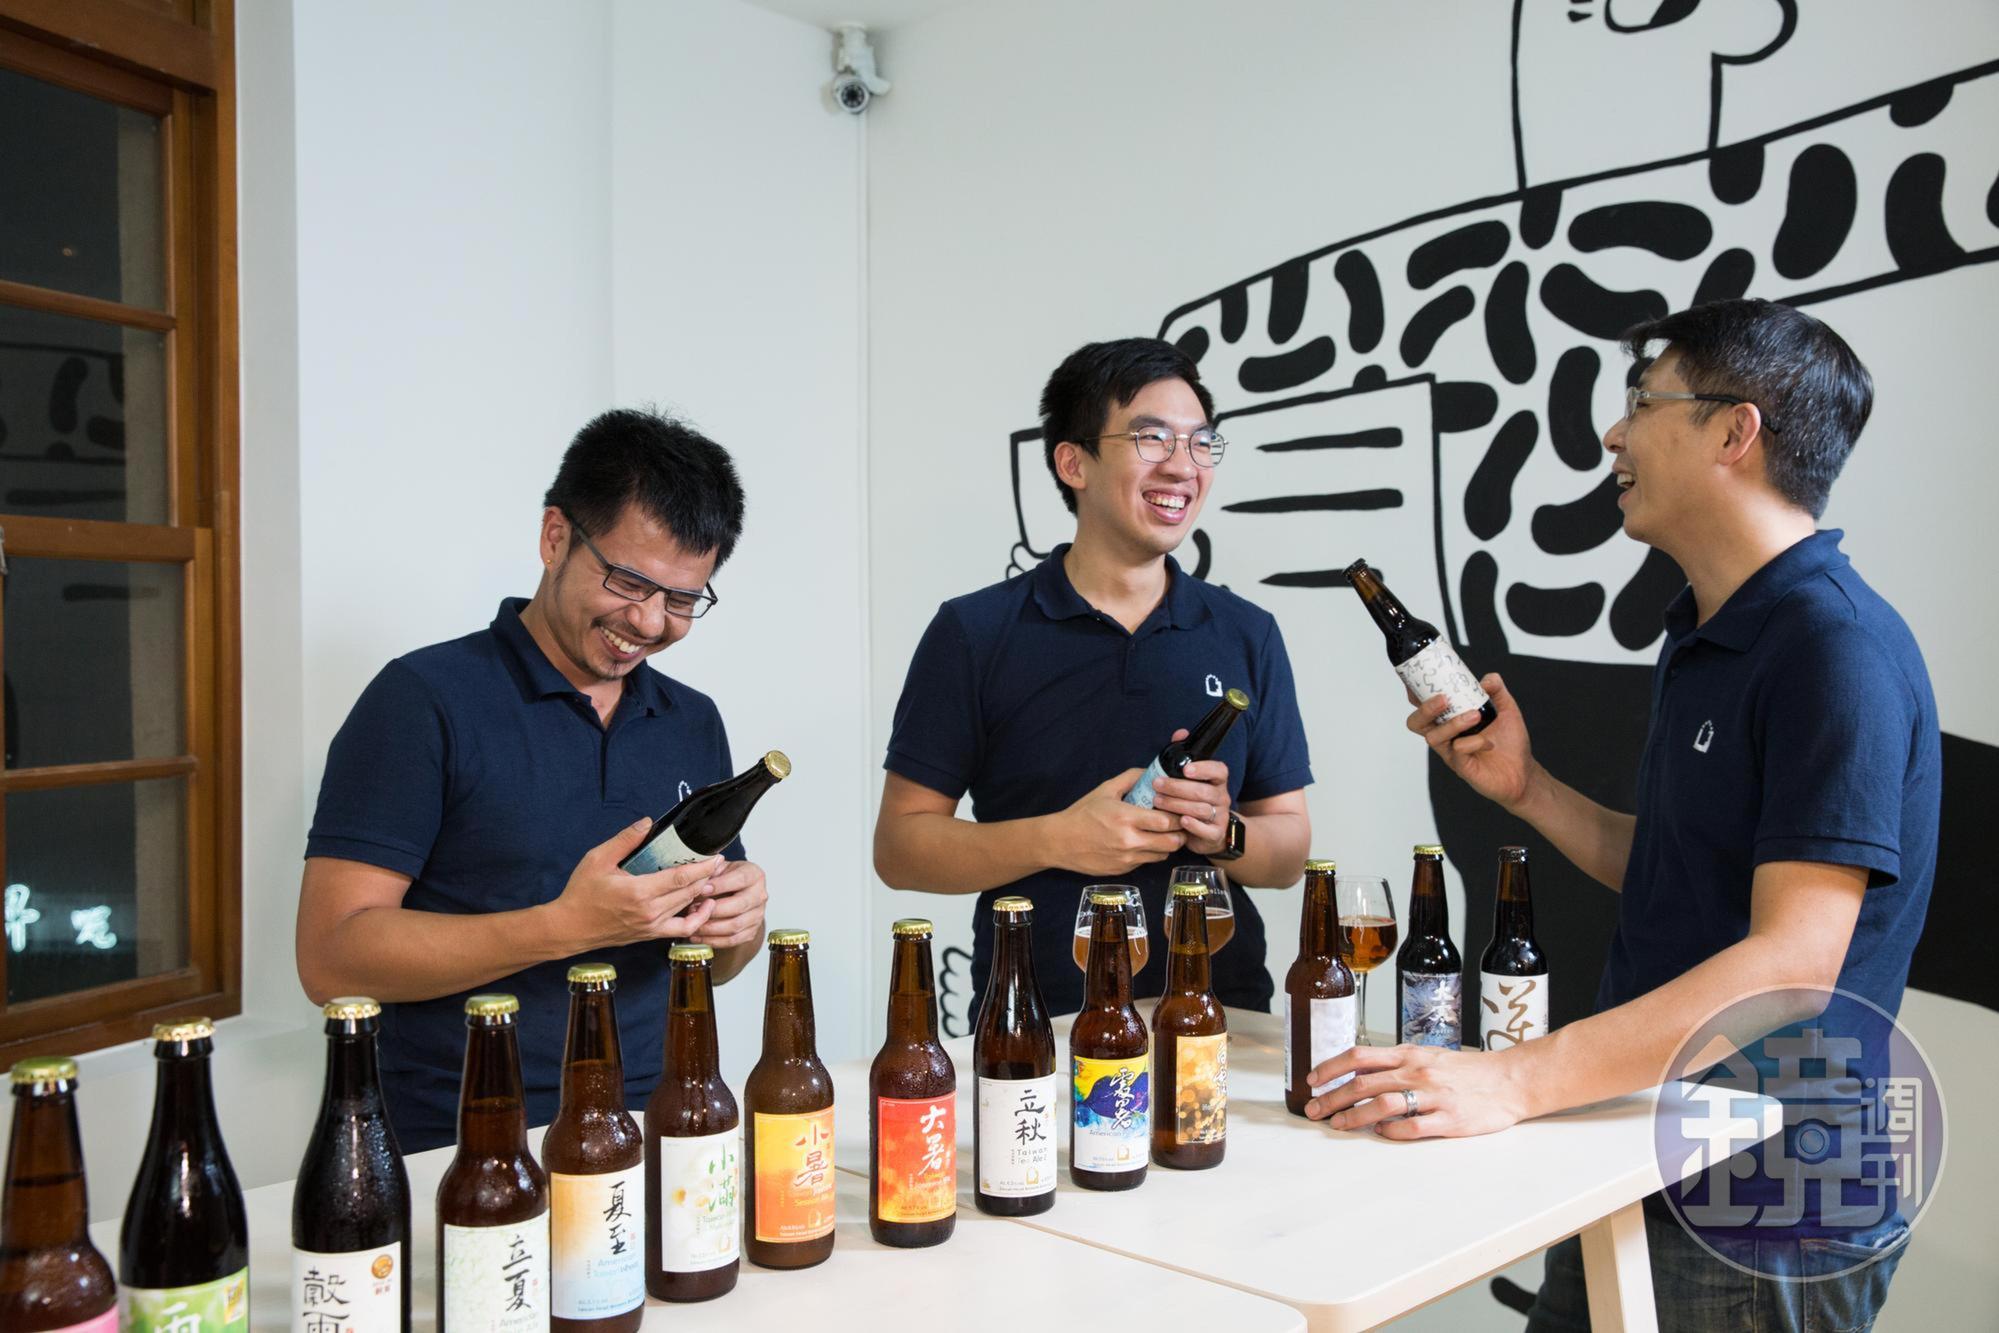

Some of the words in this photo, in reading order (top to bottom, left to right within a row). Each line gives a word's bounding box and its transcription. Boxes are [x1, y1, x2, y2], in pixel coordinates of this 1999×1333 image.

[918, 1105, 947, 1176] 大暑
[1014, 1089, 1047, 1146] 立秋
[795, 1124, 829, 1187] 小暑
[603, 1180, 632, 1255] 夏至
[502, 1234, 532, 1312] 立夏
